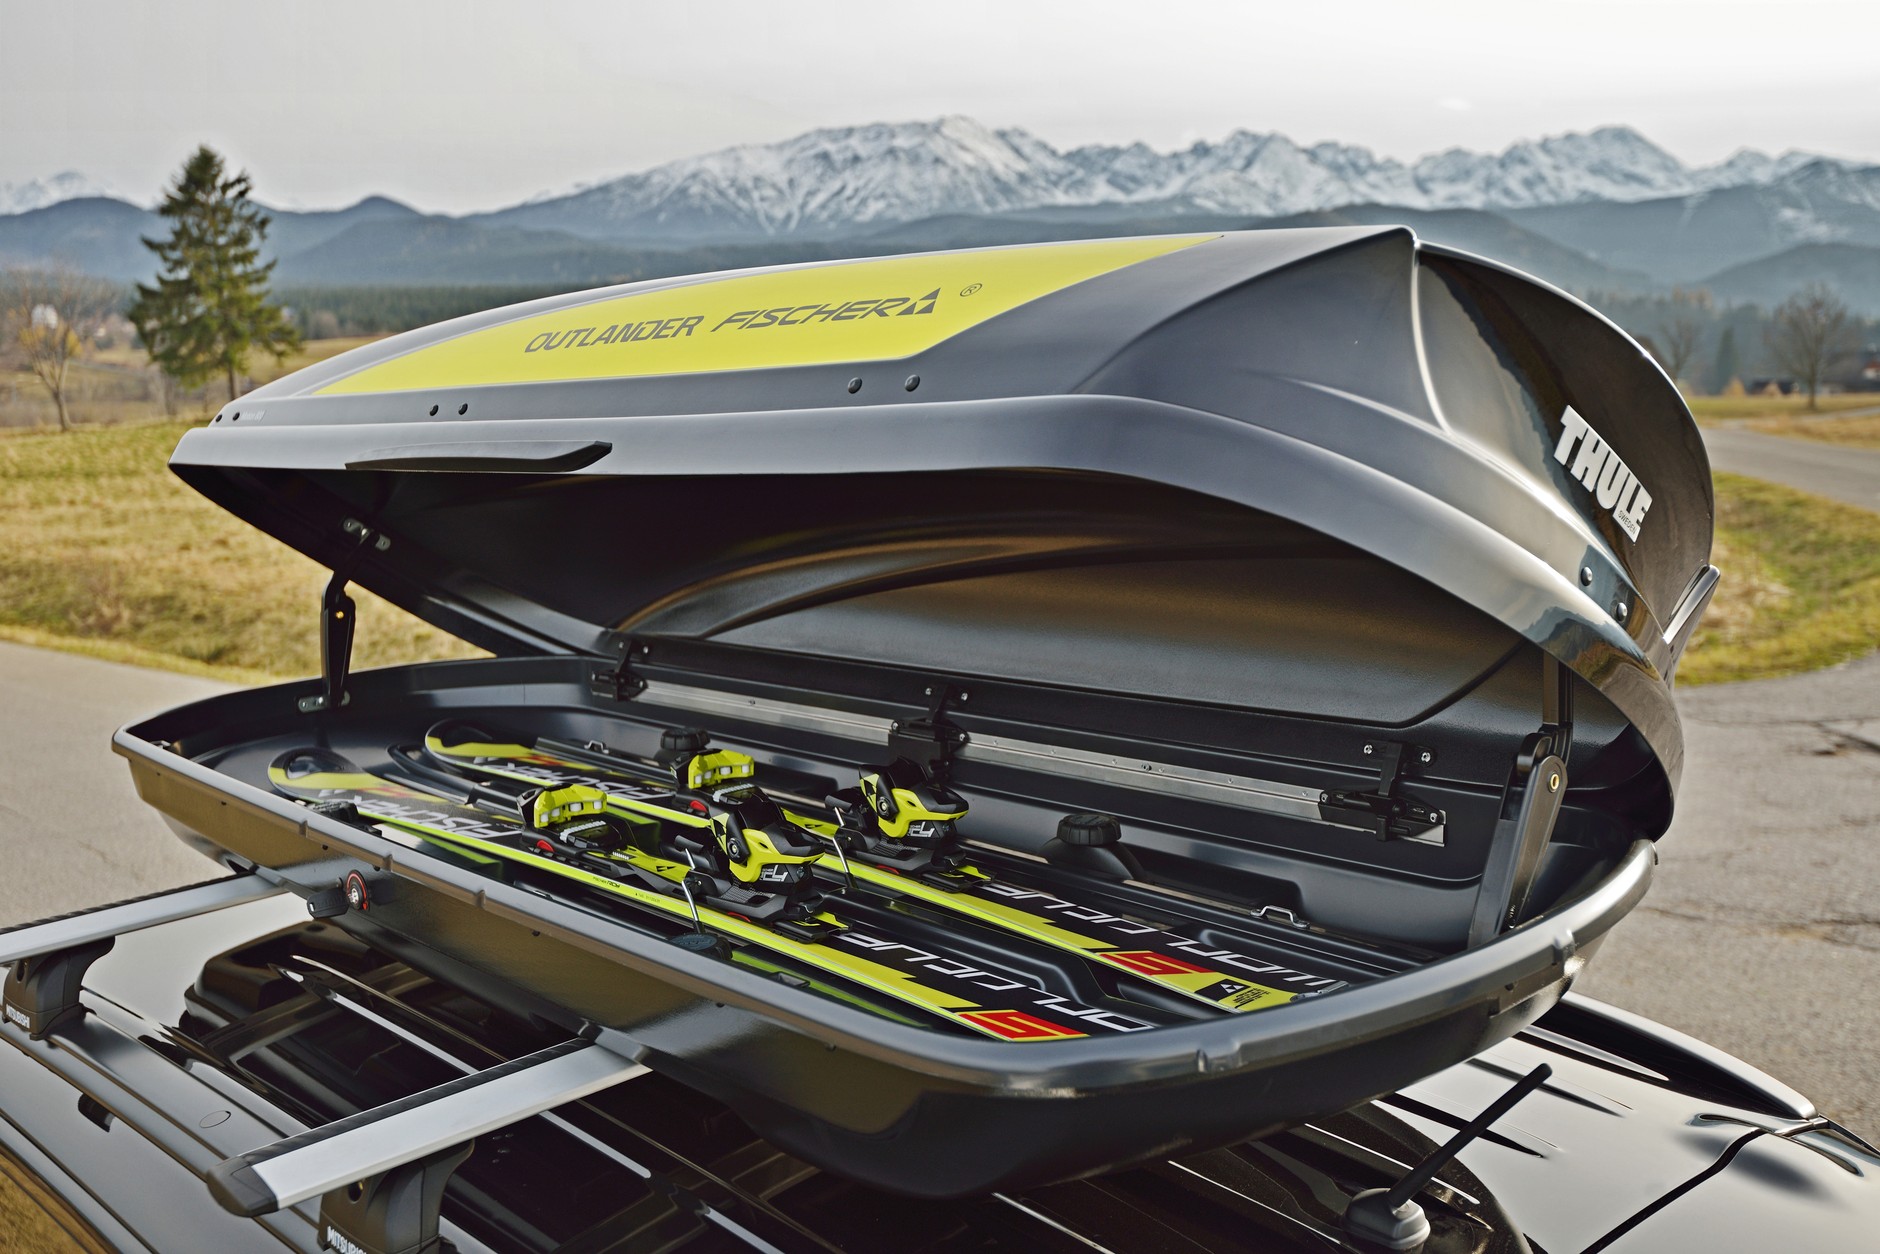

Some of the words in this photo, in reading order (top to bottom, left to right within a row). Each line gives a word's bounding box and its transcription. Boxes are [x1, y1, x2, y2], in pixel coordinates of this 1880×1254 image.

[524, 315, 705, 353] OUTLANDER
[711, 297, 912, 333] FISCHER
[1554, 405, 1653, 542] THULE
[1618, 510, 1638, 535] SWEDEN
[327, 1225, 368, 1254] MITSUB
